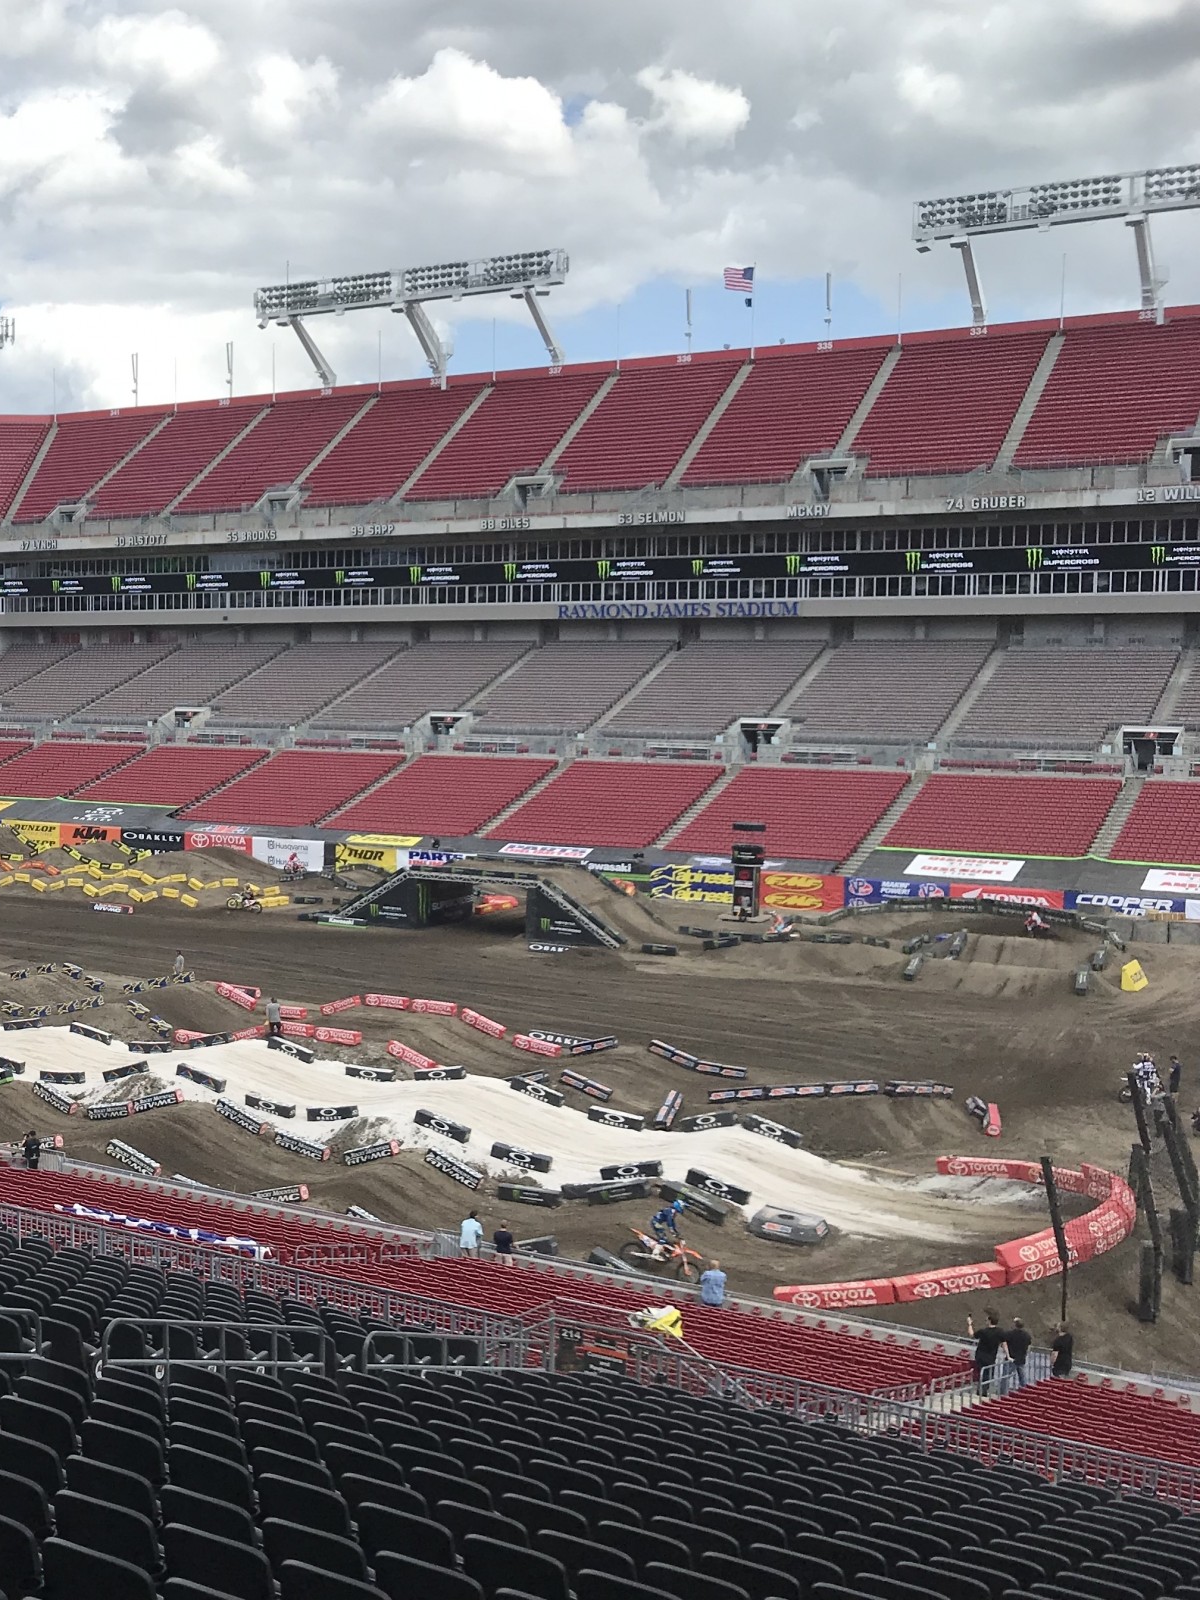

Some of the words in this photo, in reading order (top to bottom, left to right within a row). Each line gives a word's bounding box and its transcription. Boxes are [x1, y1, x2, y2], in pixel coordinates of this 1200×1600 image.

[1137, 489, 1156, 502] 12
[946, 498, 964, 511] 74
[971, 495, 1026, 510] GRUBER
[480, 519, 495, 530] 88
[499, 517, 531, 530] GILES
[617, 513, 634, 525] 63
[638, 510, 686, 524] SELMON
[226, 531, 239, 542] 55
[241, 530, 277, 542] BROOKS
[351, 526, 365, 536] 99
[368, 524, 395, 536] SAPP
[114, 536, 126, 547] 40
[129, 534, 168, 547] ALSTOTT
[558, 604, 649, 619] RAYMOND
[650, 602, 711, 618] JAMES
[715, 601, 800, 617] STADIUM
[13, 823, 56, 832] DUNLOP
[72, 827, 108, 840] KTM
[138, 833, 182, 843] OAKLEY
[210, 834, 246, 845] TOYOTA
[275, 841, 309, 851] Husqvarna
[347, 848, 385, 861] THOR
[580, 859, 632, 873] Kawasaki
[765, 876, 823, 889] FMF
[765, 895, 823, 908] FMF
[982, 892, 1050, 907] HONDA
[1075, 894, 1174, 912] COOPER
[230, 992, 251, 1007] TOYOTA
[379, 997, 403, 1005] TOYOTA
[427, 1002, 451, 1012] TOYOTA
[283, 1023, 307, 1033] TOYOTA
[476, 1019, 501, 1034] TOYOTA
[235, 1028, 258, 1039] TOYOTA
[330, 1030, 354, 1040] TOYOTA
[530, 1042, 556, 1053] TOYOTA
[404, 1050, 429, 1067] TOYOTA
[969, 1163, 1008, 1173] TOYOTA
[942, 1273, 991, 1288] TOYOTA
[822, 1288, 876, 1300] TOYOTA
